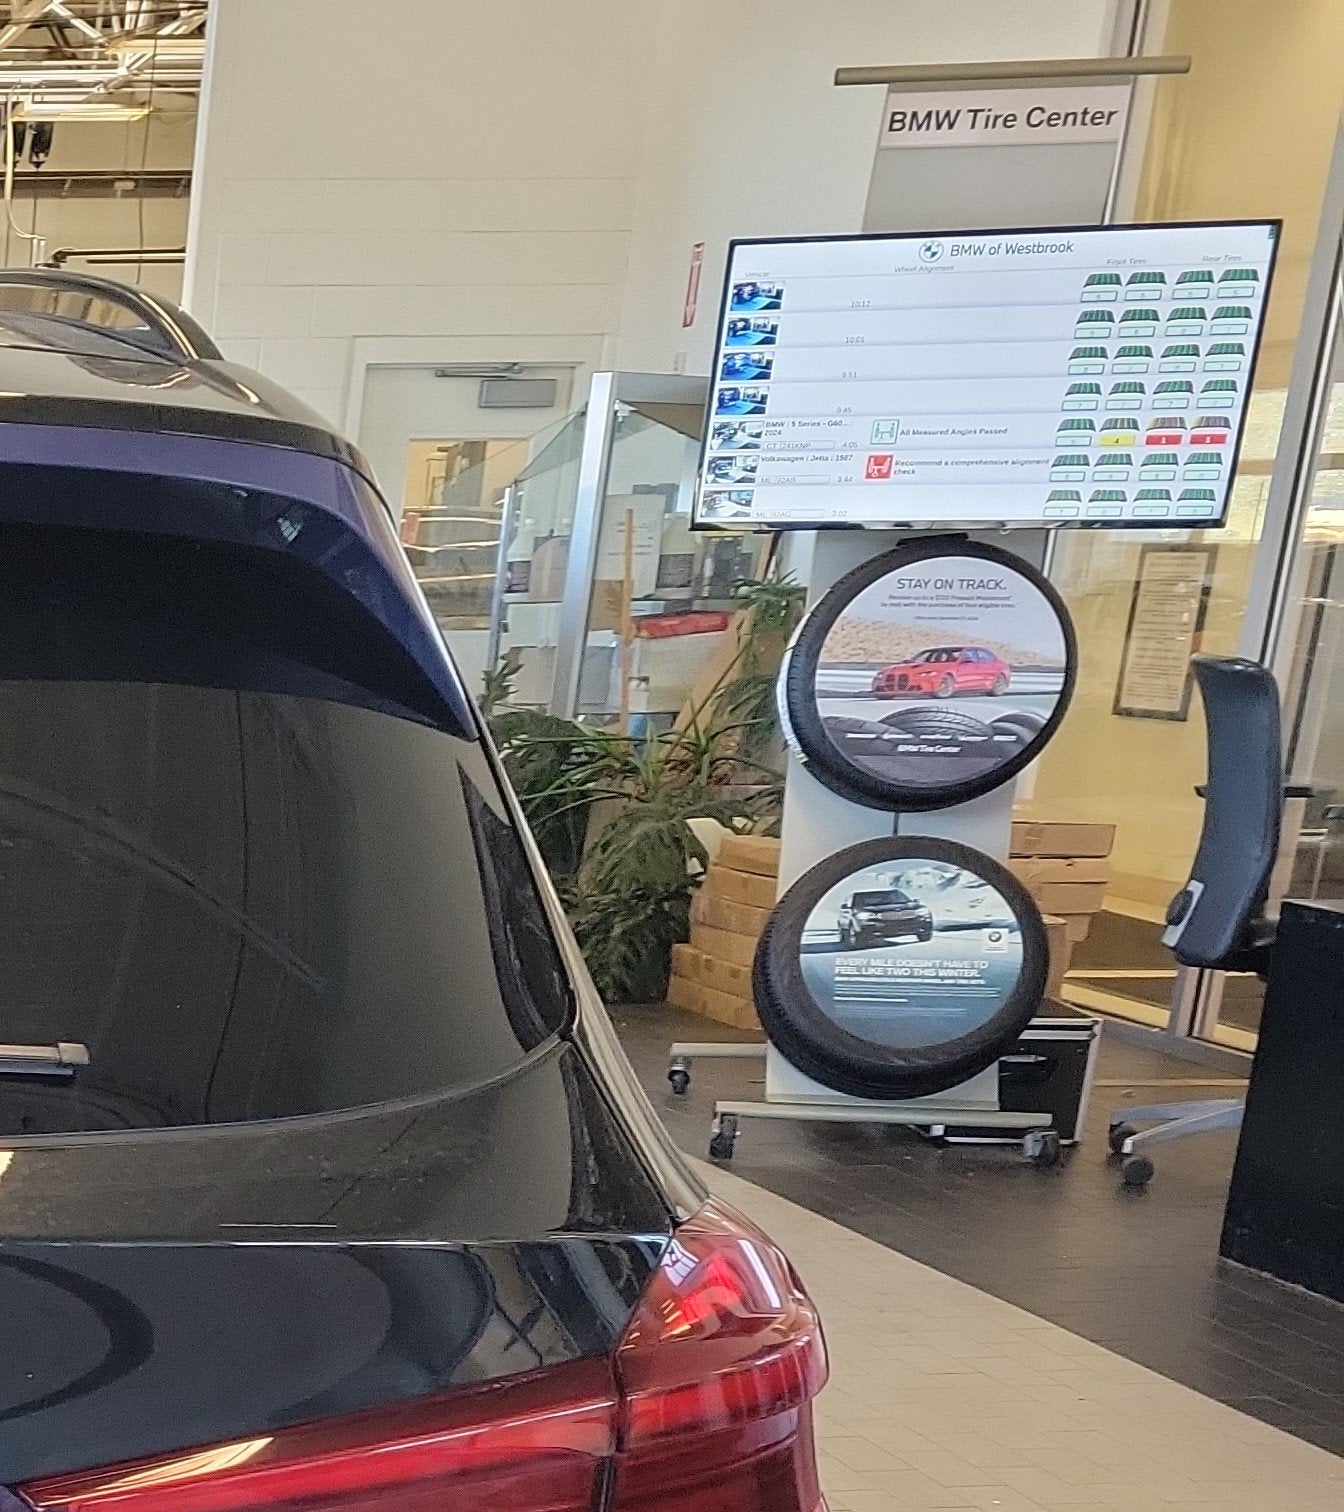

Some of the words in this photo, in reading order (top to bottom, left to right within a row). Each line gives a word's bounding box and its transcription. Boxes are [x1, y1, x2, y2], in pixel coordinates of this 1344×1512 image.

[888, 109, 962, 132] BMW
[966, 107, 1018, 130] Tire
[1025, 105, 1119, 129] Center
[950, 243, 986, 257] BMW
[988, 242, 1004, 256] of
[1005, 241, 1074, 256] Westbrook
[919, 264, 955, 273] Alignment
[912, 428, 949, 436] Measured
[950, 428, 977, 437] Angles
[979, 427, 1008, 435] Passed
[760, 455, 804, 463] Volkswagen
[895, 459, 942, 467] Recommend
[950, 459, 1009, 467] comprehensive
[1010, 458, 1050, 467] alignment
[896, 578, 932, 590] STAY
[934, 578, 955, 590] ON
[957, 578, 1007, 590] TRACK.
[835, 958, 868, 967] EVERY
[870, 958, 895, 967] MILE
[897, 959, 941, 968] DOESN'T
[944, 960, 972, 969] HAVE
[974, 960, 989, 969] TO
[834, 966, 860, 975] FEEL
[862, 967, 885, 975] LIKE
[886, 967, 911, 976] TWO
[912, 968, 937, 976] THIS
